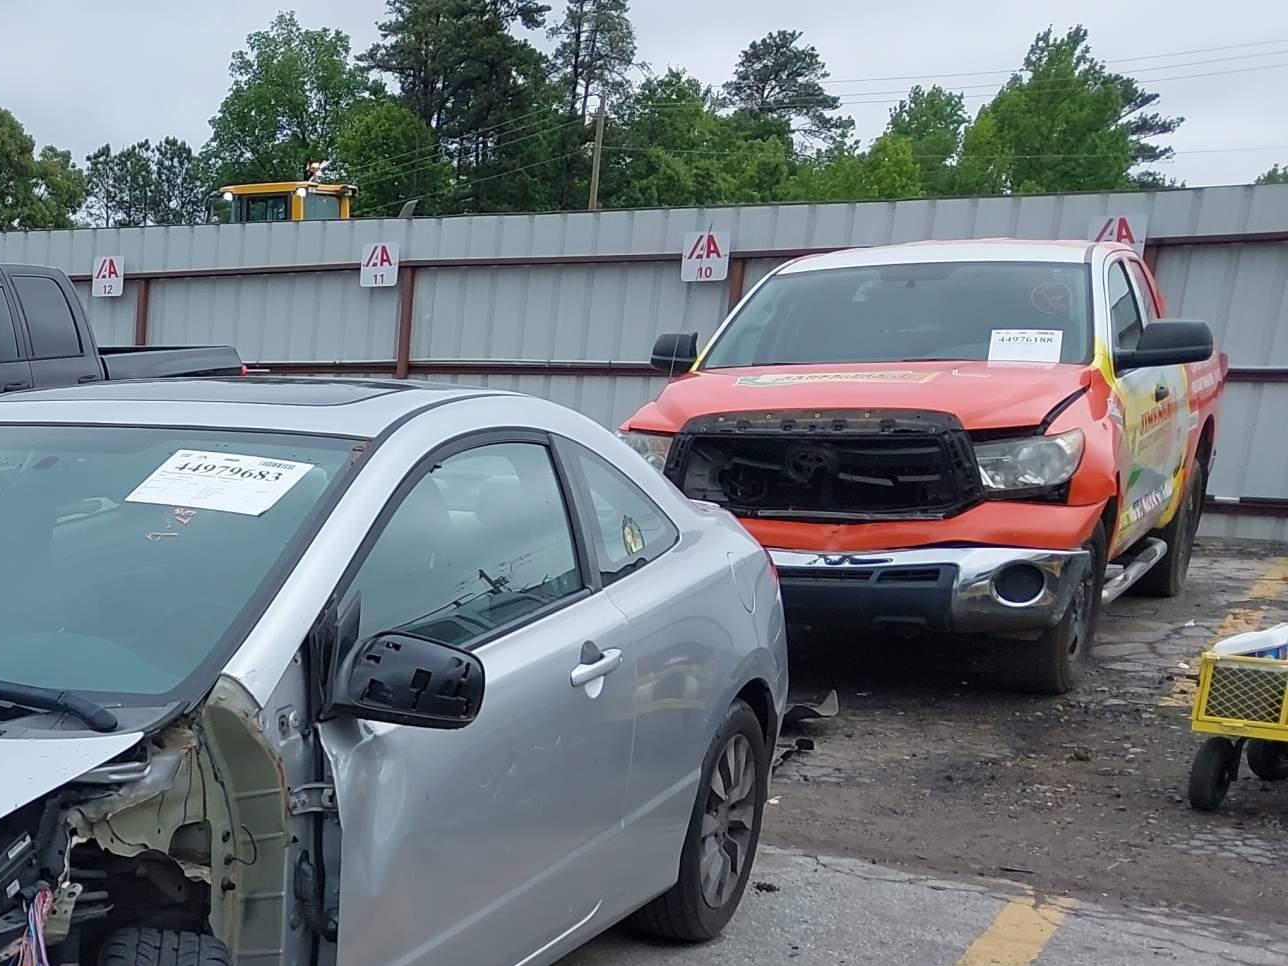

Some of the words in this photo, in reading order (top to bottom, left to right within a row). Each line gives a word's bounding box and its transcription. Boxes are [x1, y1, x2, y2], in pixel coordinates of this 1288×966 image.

[697, 266, 713, 279] 10
[373, 273, 385, 285] 11
[103, 284, 113, 295] 12
[174, 461, 283, 482] 44979683
